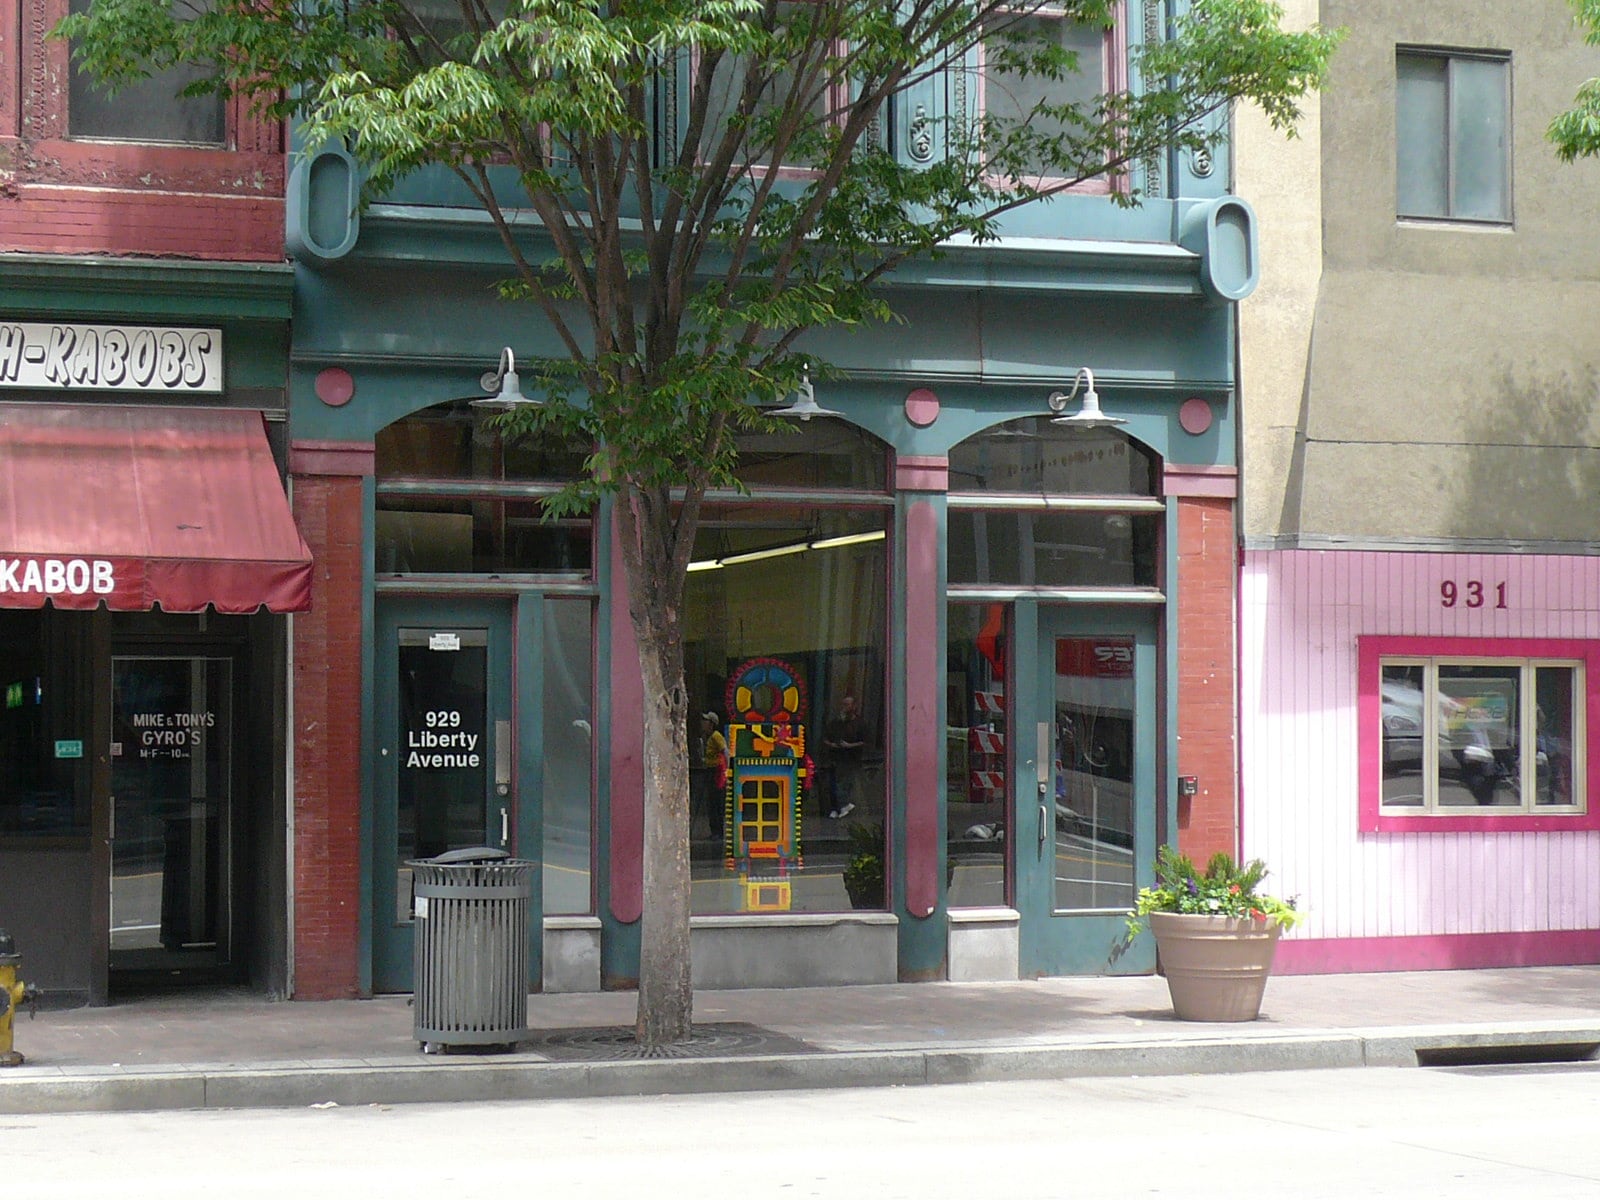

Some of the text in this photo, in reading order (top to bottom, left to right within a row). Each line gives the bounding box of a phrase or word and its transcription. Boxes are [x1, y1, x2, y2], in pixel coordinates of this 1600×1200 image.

[0, 559, 115, 594] KABOB
[1440, 580, 1507, 609] 931
[133, 713, 164, 727] MIKE
[175, 710, 215, 727] TONY'S
[425, 711, 461, 728] 929
[142, 728, 201, 746] GYRO'S
[408, 731, 478, 752] Liberty
[406, 751, 480, 768] Avenue
